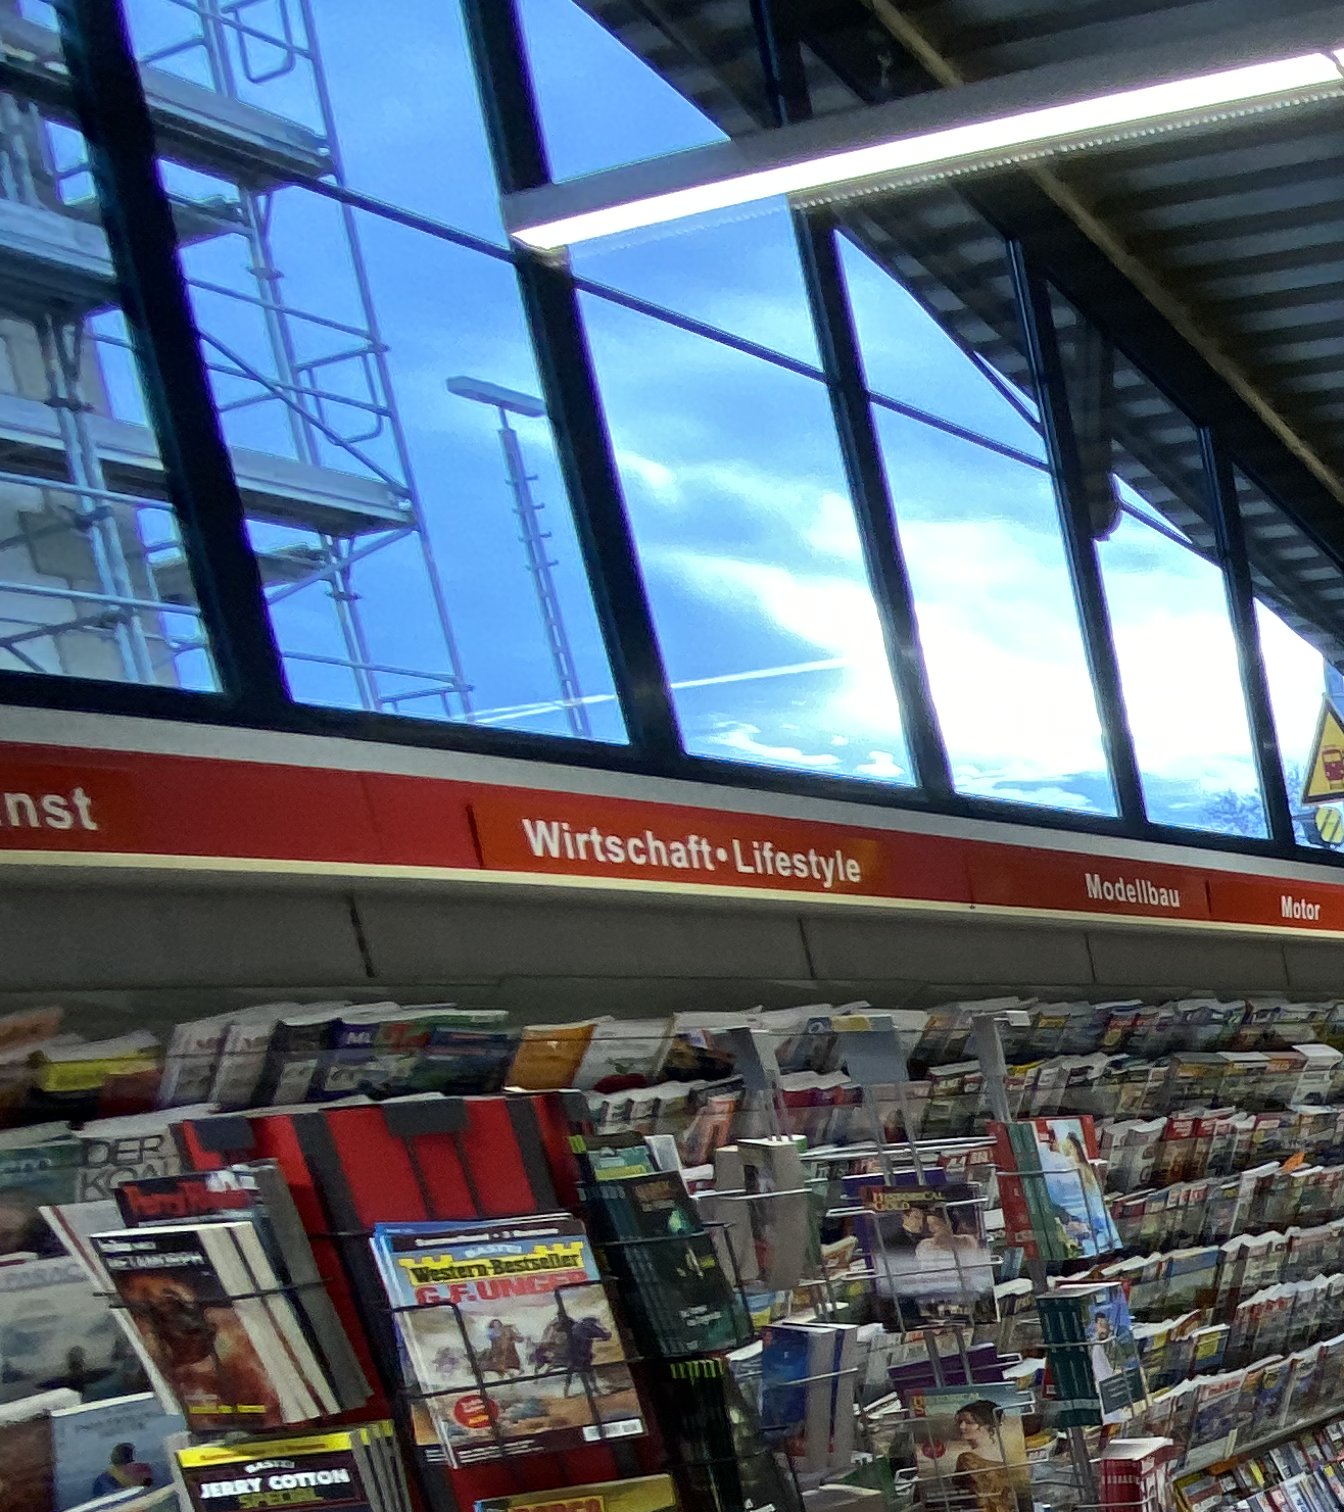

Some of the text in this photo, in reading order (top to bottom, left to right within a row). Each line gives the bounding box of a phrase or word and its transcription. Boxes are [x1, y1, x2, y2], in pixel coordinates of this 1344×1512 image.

[0, 787, 99, 831] nst
[1084, 872, 1180, 908] Modellbau
[1281, 895, 1320, 921] Motor
[268, 1467, 351, 1491] COTTON
